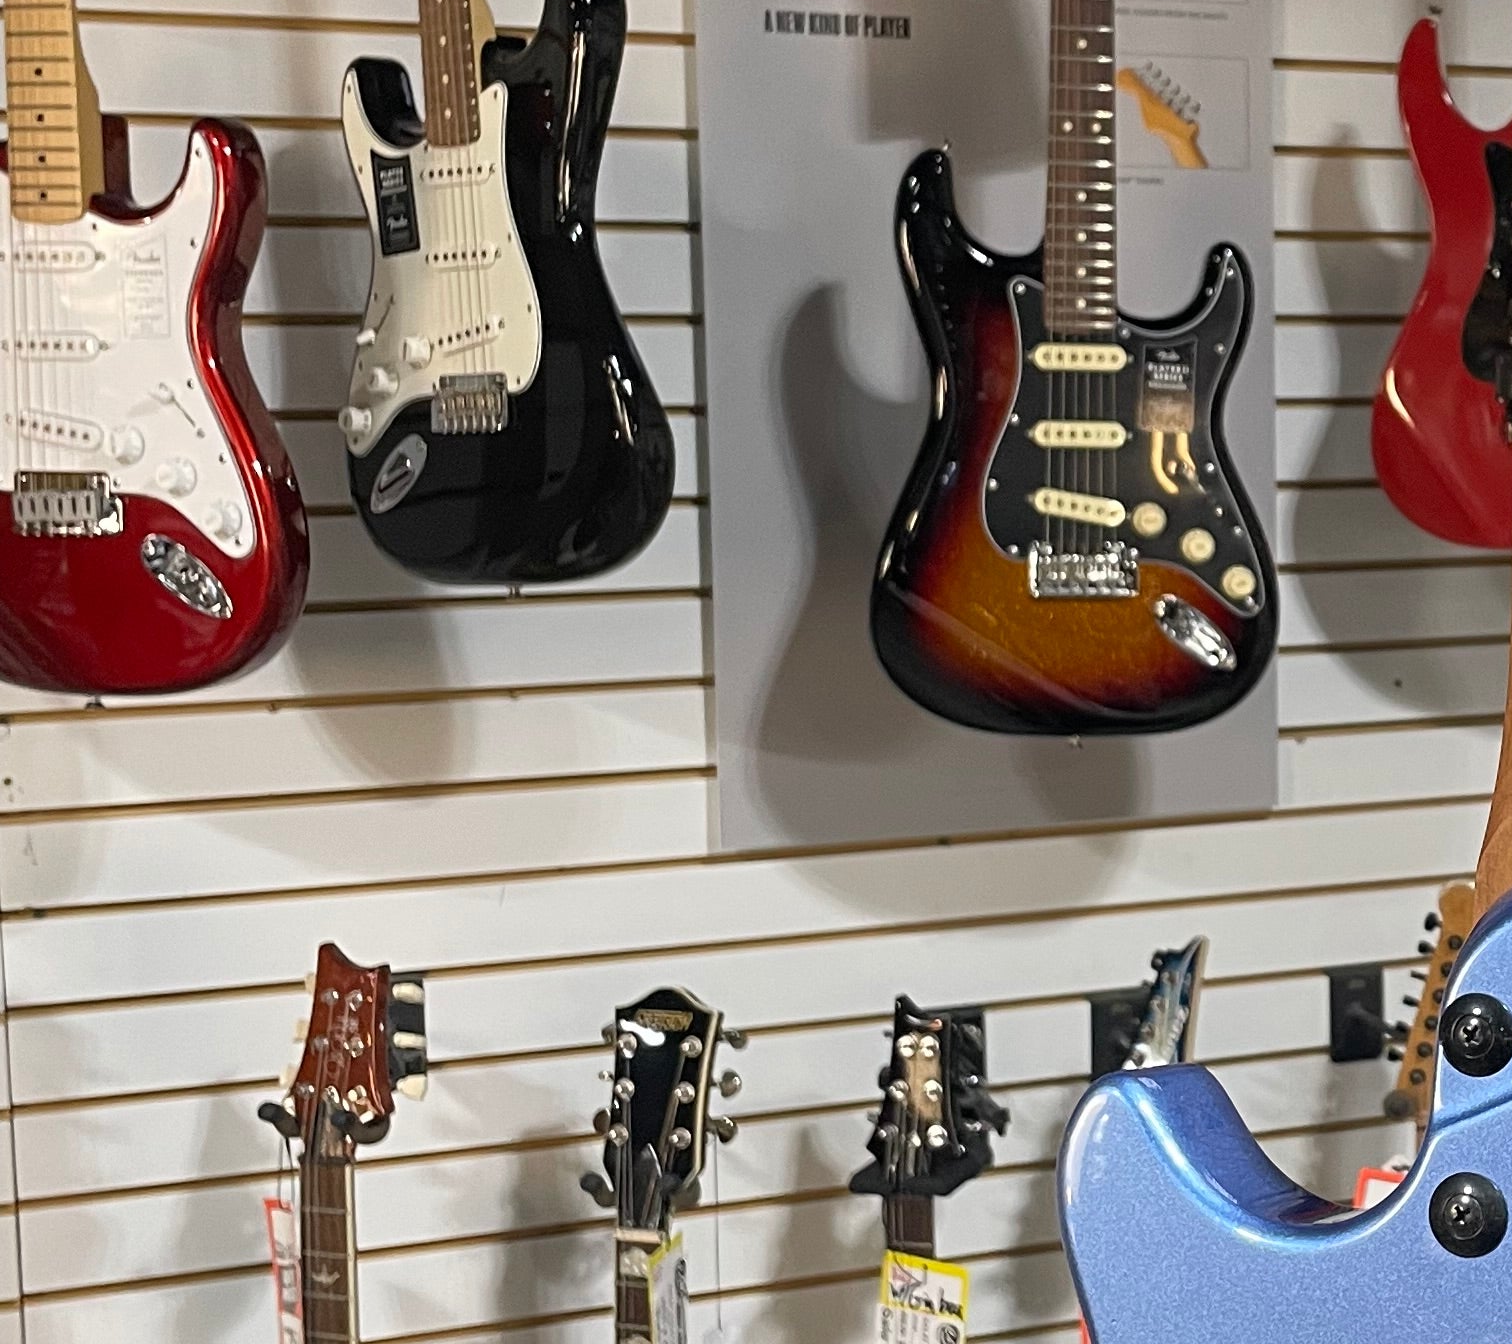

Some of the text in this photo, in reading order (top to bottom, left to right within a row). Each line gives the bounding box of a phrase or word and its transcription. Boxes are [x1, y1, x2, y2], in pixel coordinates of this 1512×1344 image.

[764, 9, 774, 33] A
[776, 10, 806, 34] NEW
[864, 15, 911, 39] PLAYER
